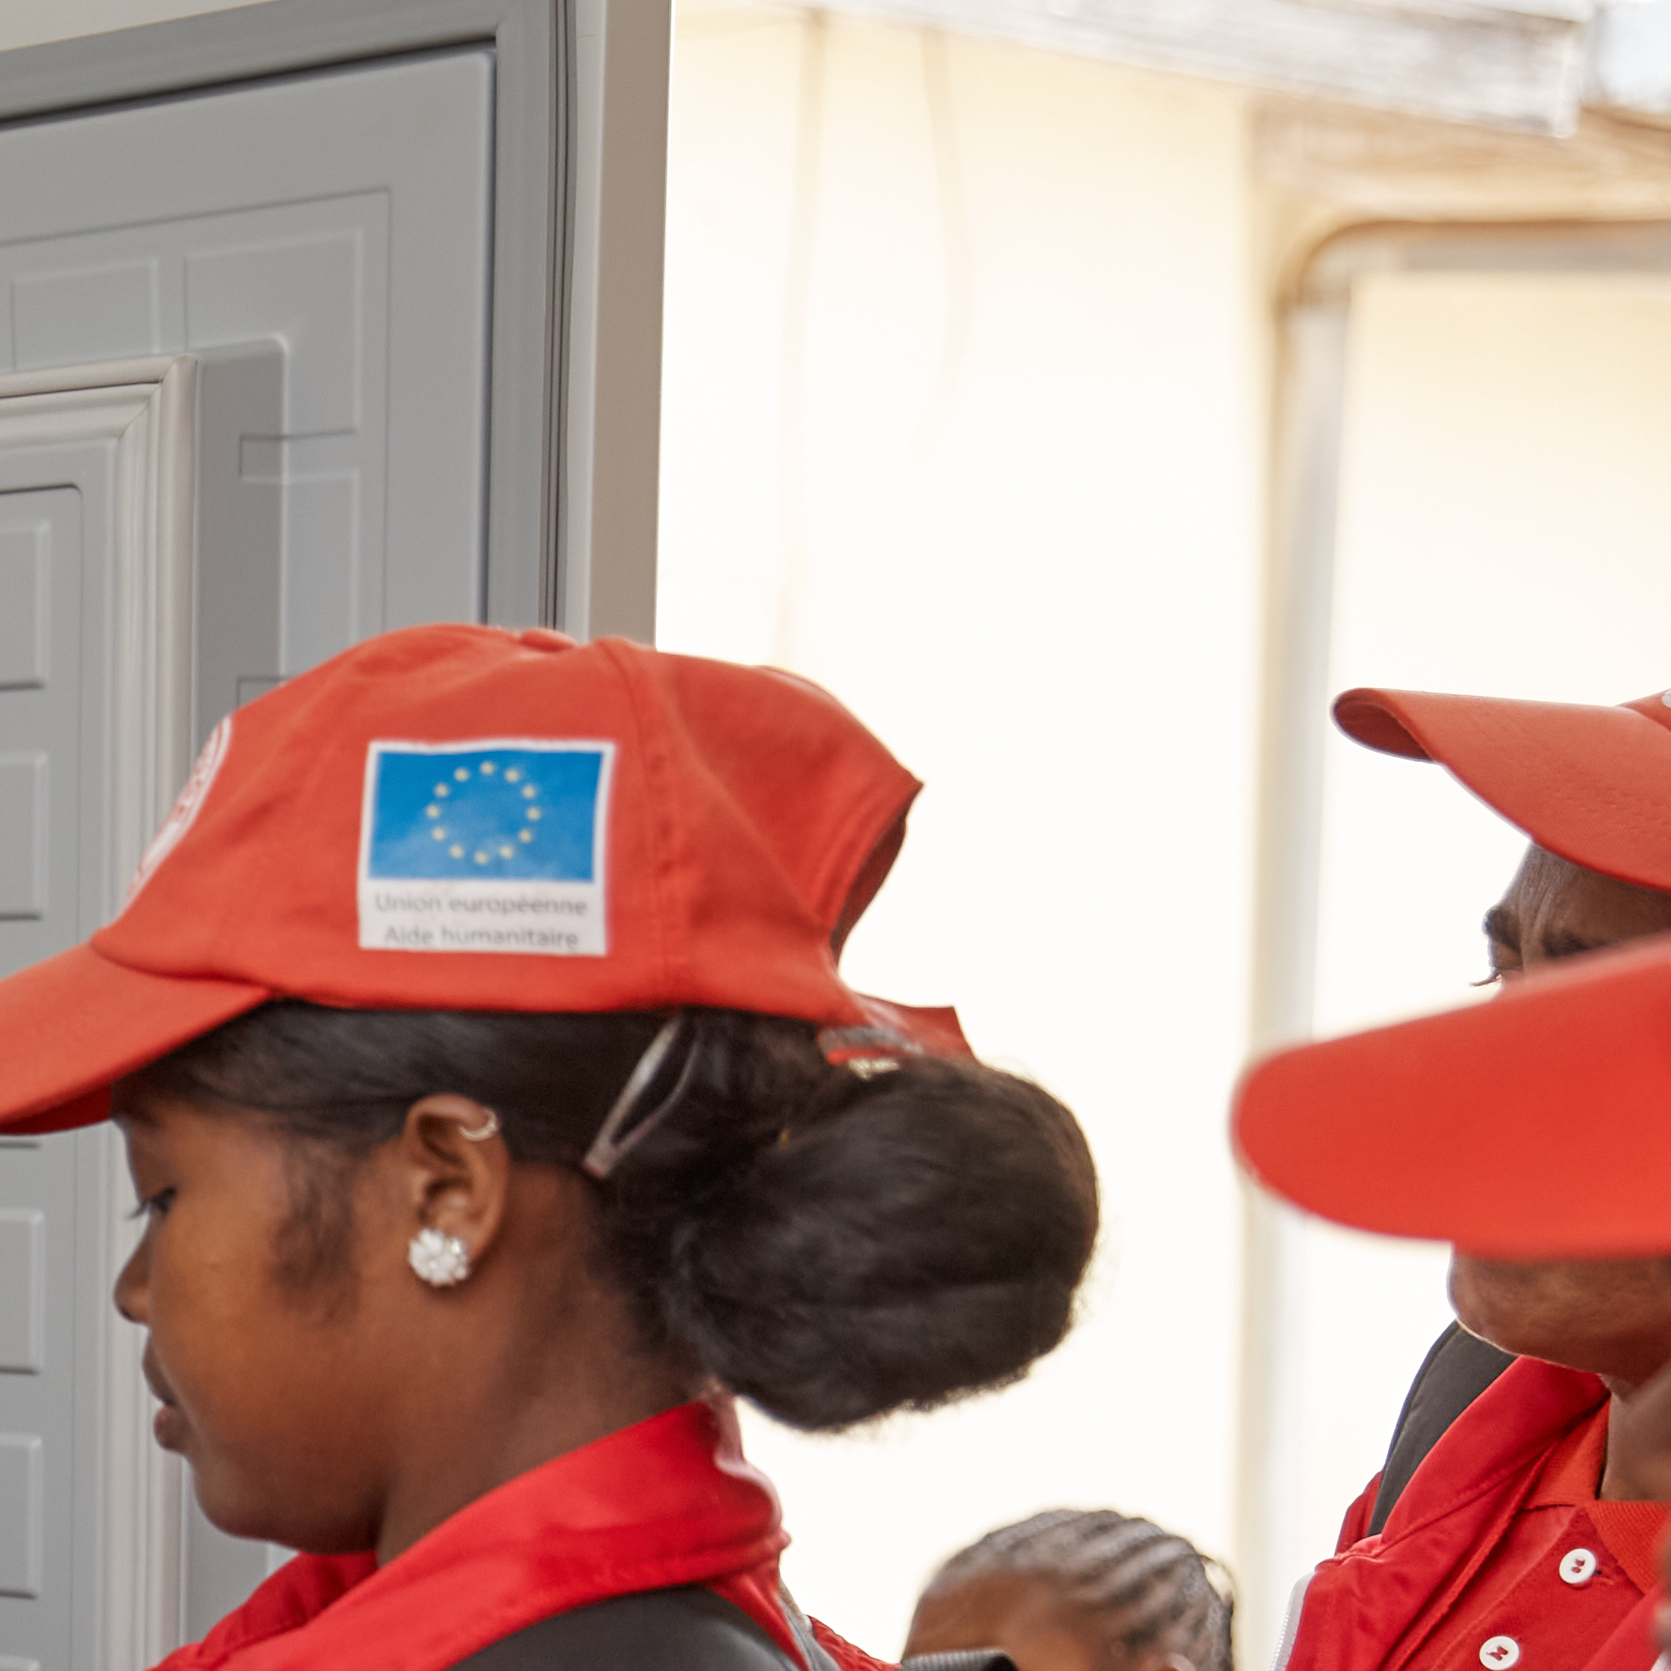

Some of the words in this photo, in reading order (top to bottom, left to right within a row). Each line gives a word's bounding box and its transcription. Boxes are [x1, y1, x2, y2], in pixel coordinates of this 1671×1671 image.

[374, 893, 442, 913] Union
[448, 895, 589, 917] européenne
[383, 925, 434, 946] Aide
[441, 926, 579, 949] humanitaire
